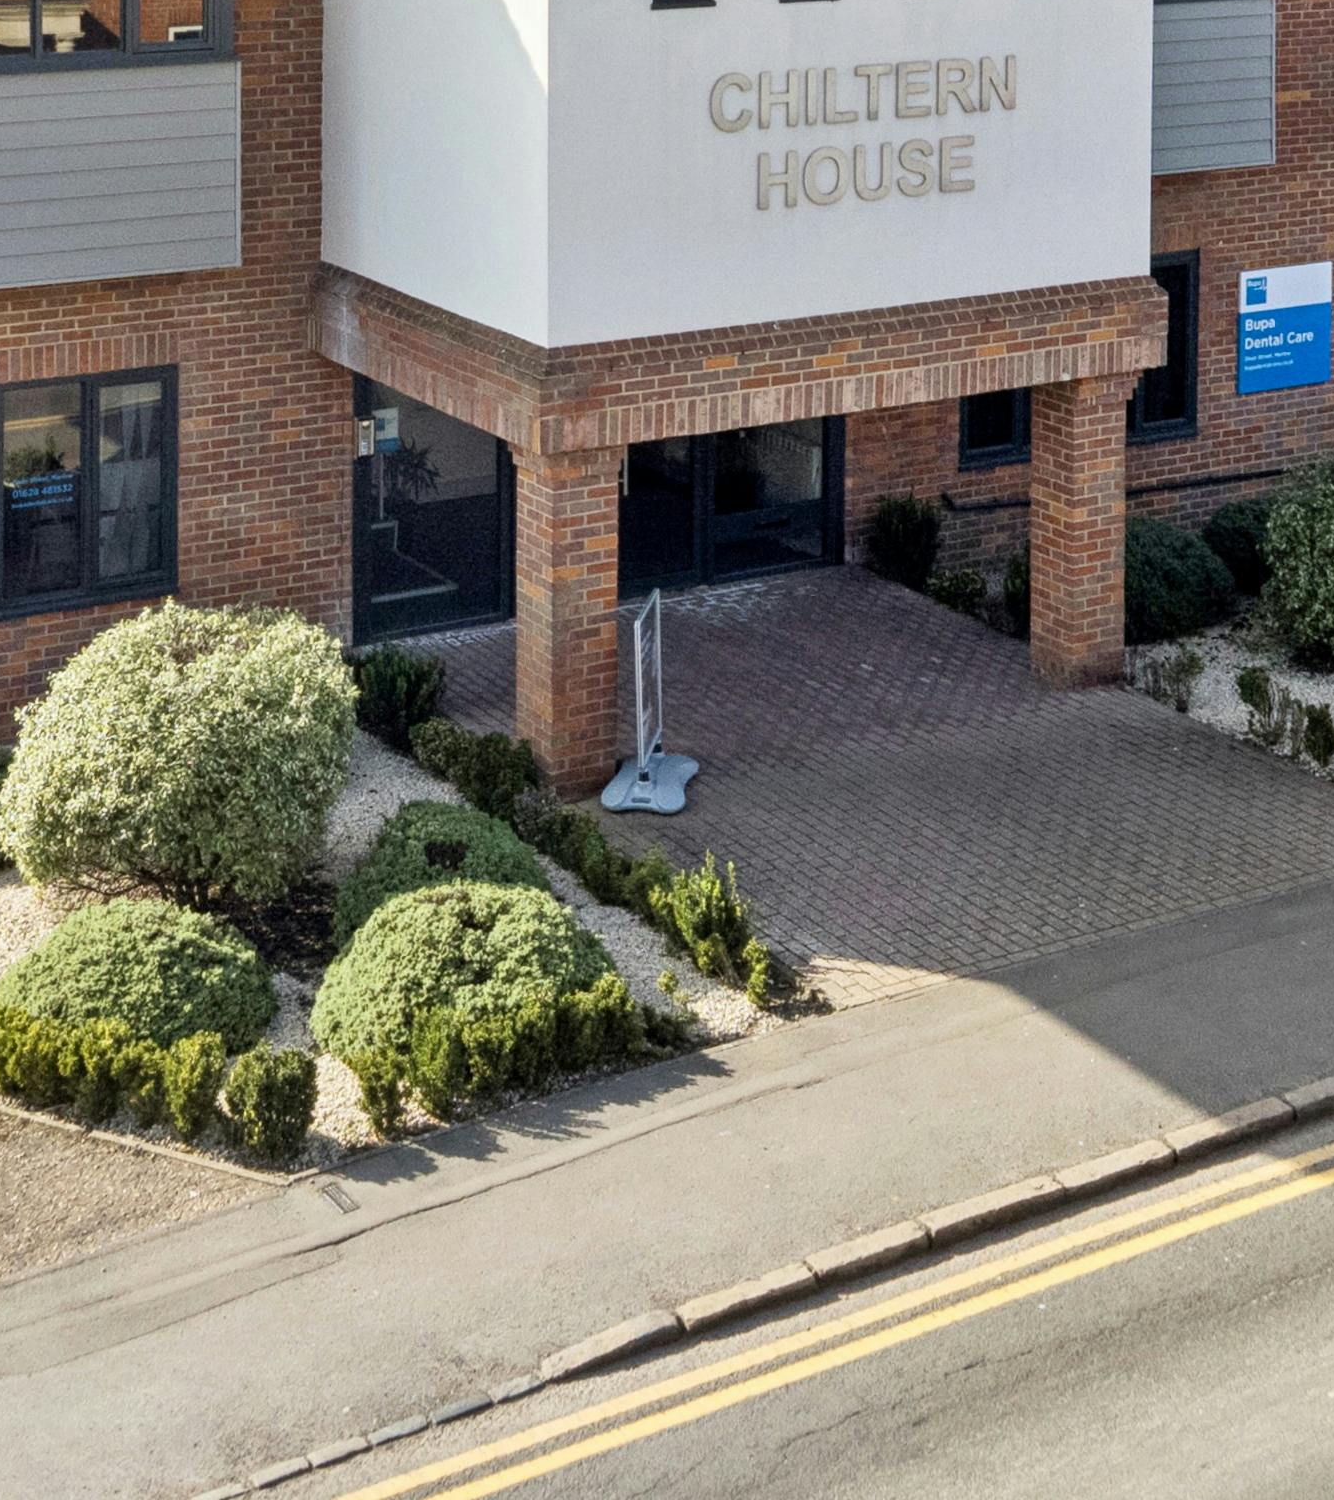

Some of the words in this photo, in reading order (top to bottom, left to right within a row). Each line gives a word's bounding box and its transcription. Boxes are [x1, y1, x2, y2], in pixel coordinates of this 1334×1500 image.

[709, 54, 1017, 133] CHILTERN
[756, 134, 976, 211] HOUSE
[1244, 318, 1276, 332] Bupa
[1244, 333, 1283, 350] Dental
[1287, 331, 1314, 344] Care
[12, 487, 40, 498] 01628
